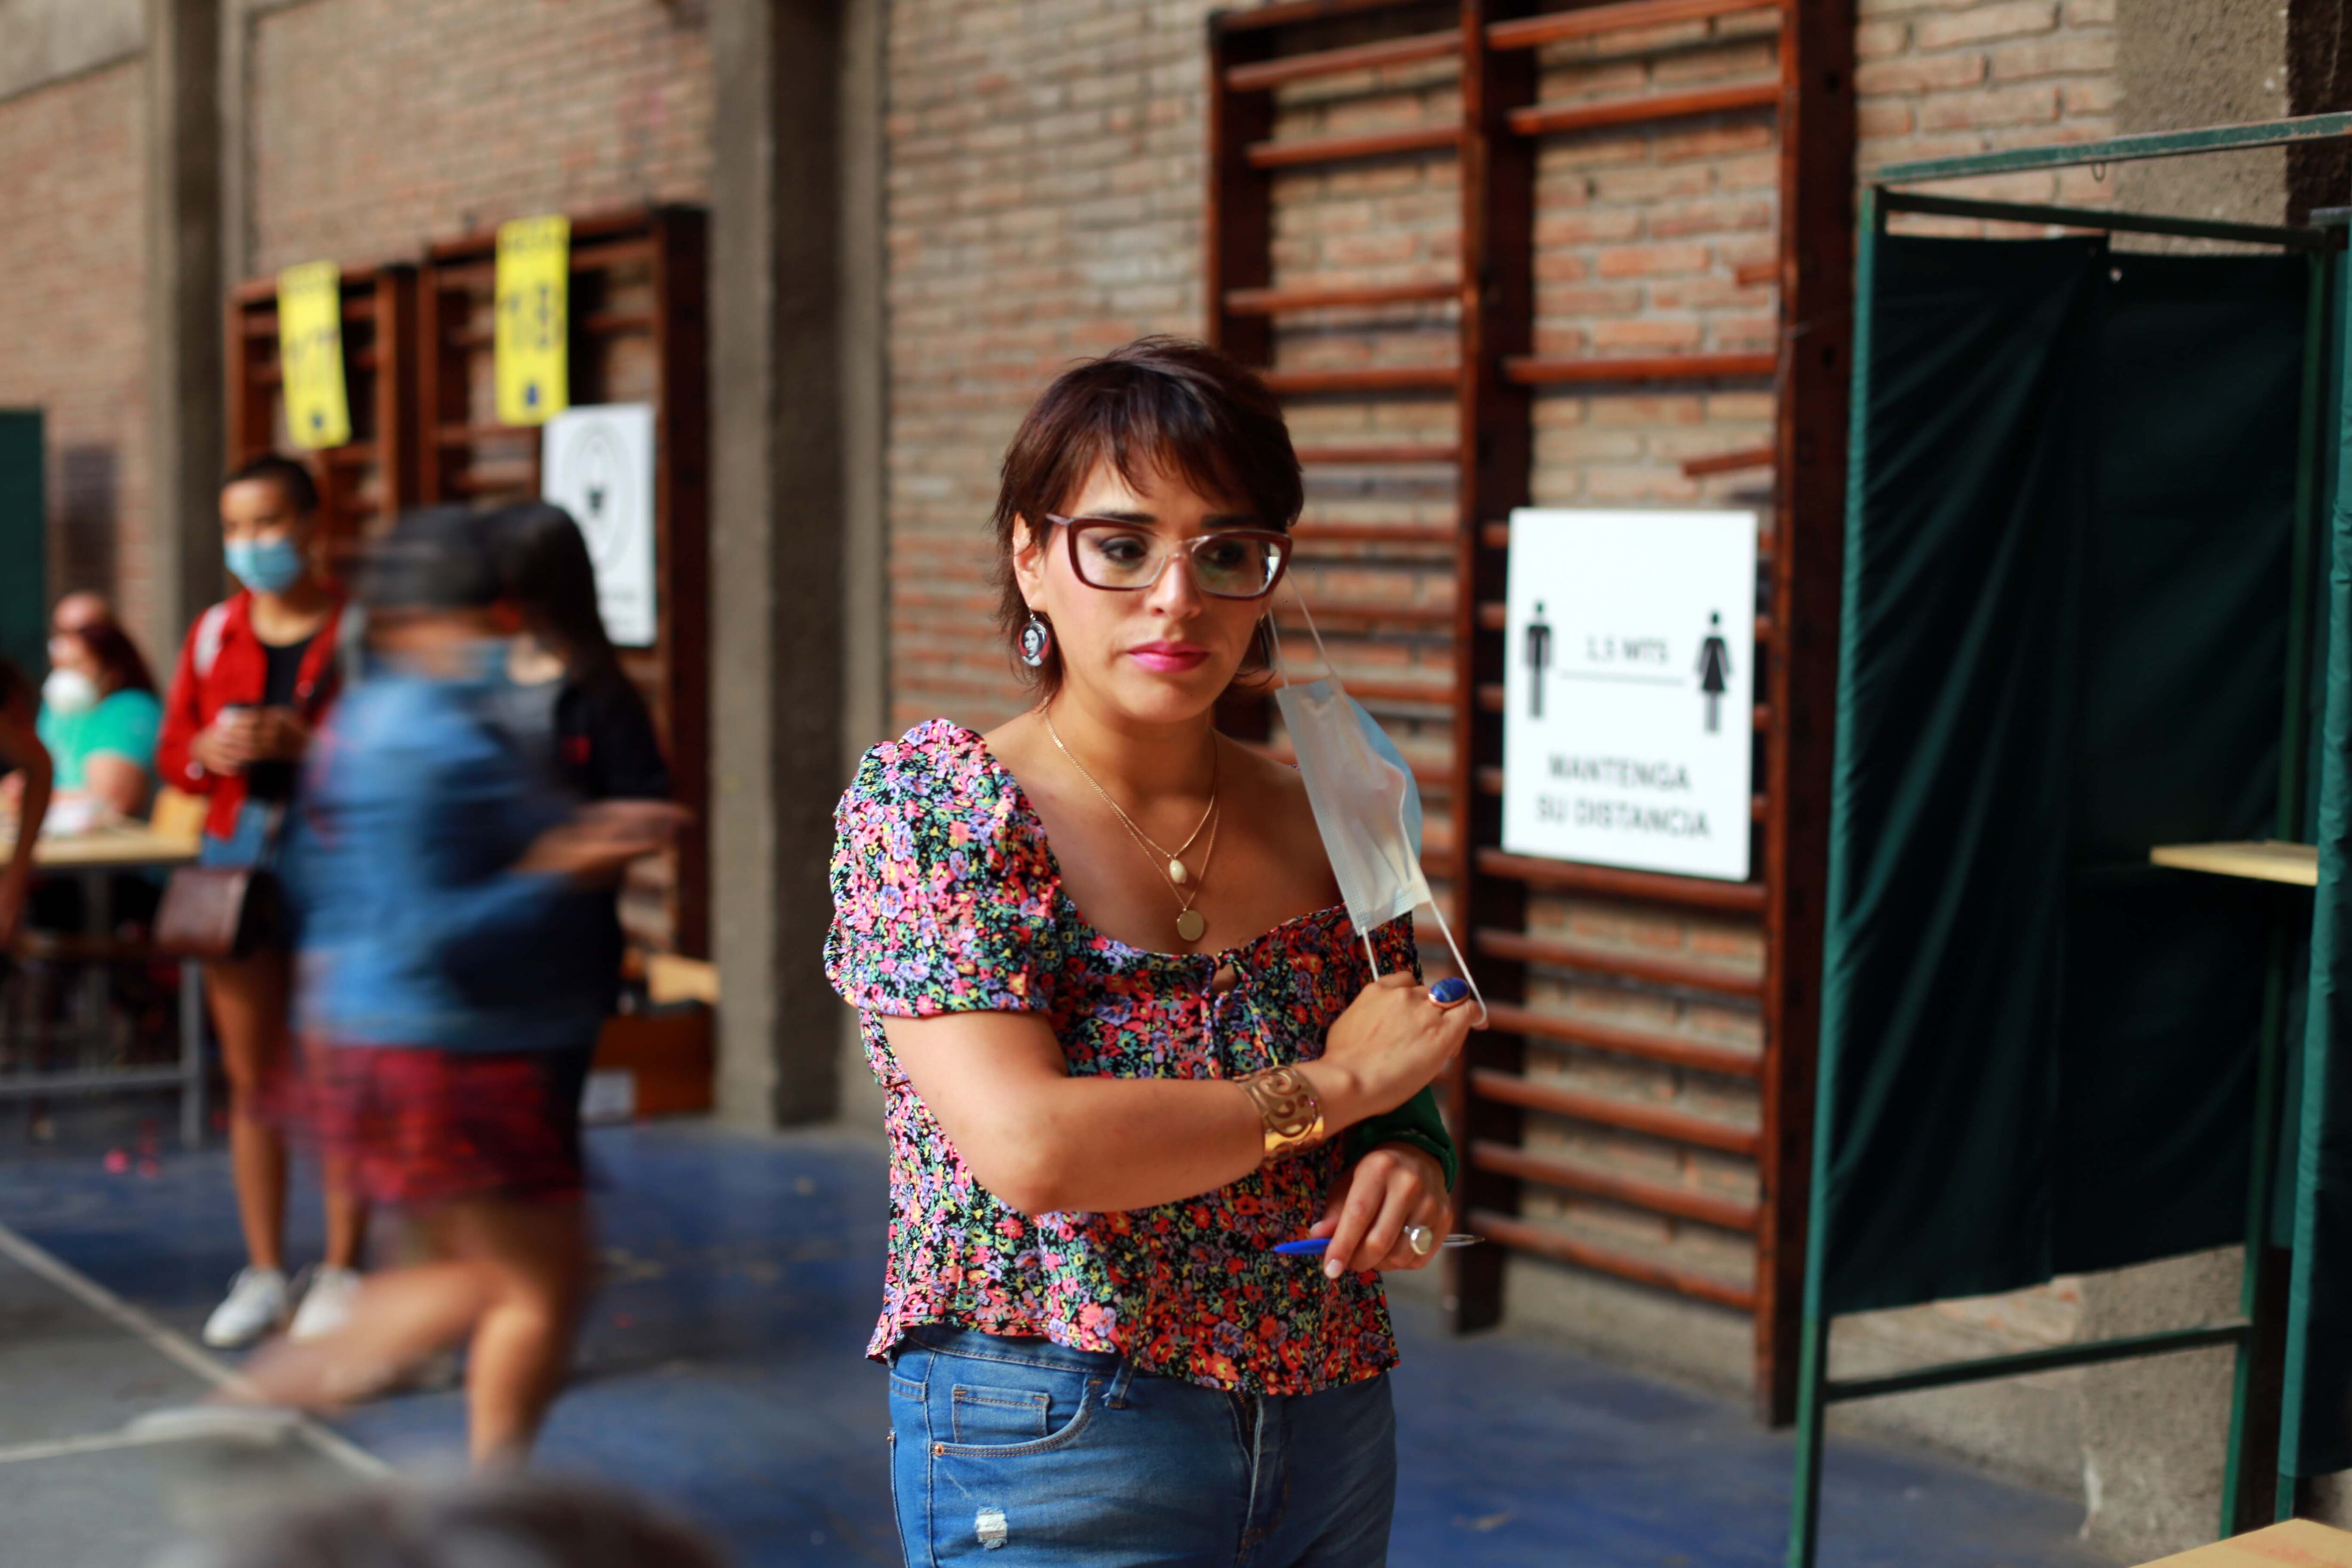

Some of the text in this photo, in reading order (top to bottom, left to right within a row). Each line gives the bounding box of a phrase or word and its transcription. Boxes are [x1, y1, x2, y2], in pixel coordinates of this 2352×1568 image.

[1624, 636, 1669, 665] MTS
[1549, 755, 1690, 789] MANTENGA
[1537, 794, 1709, 836] SU DISTANCIA
